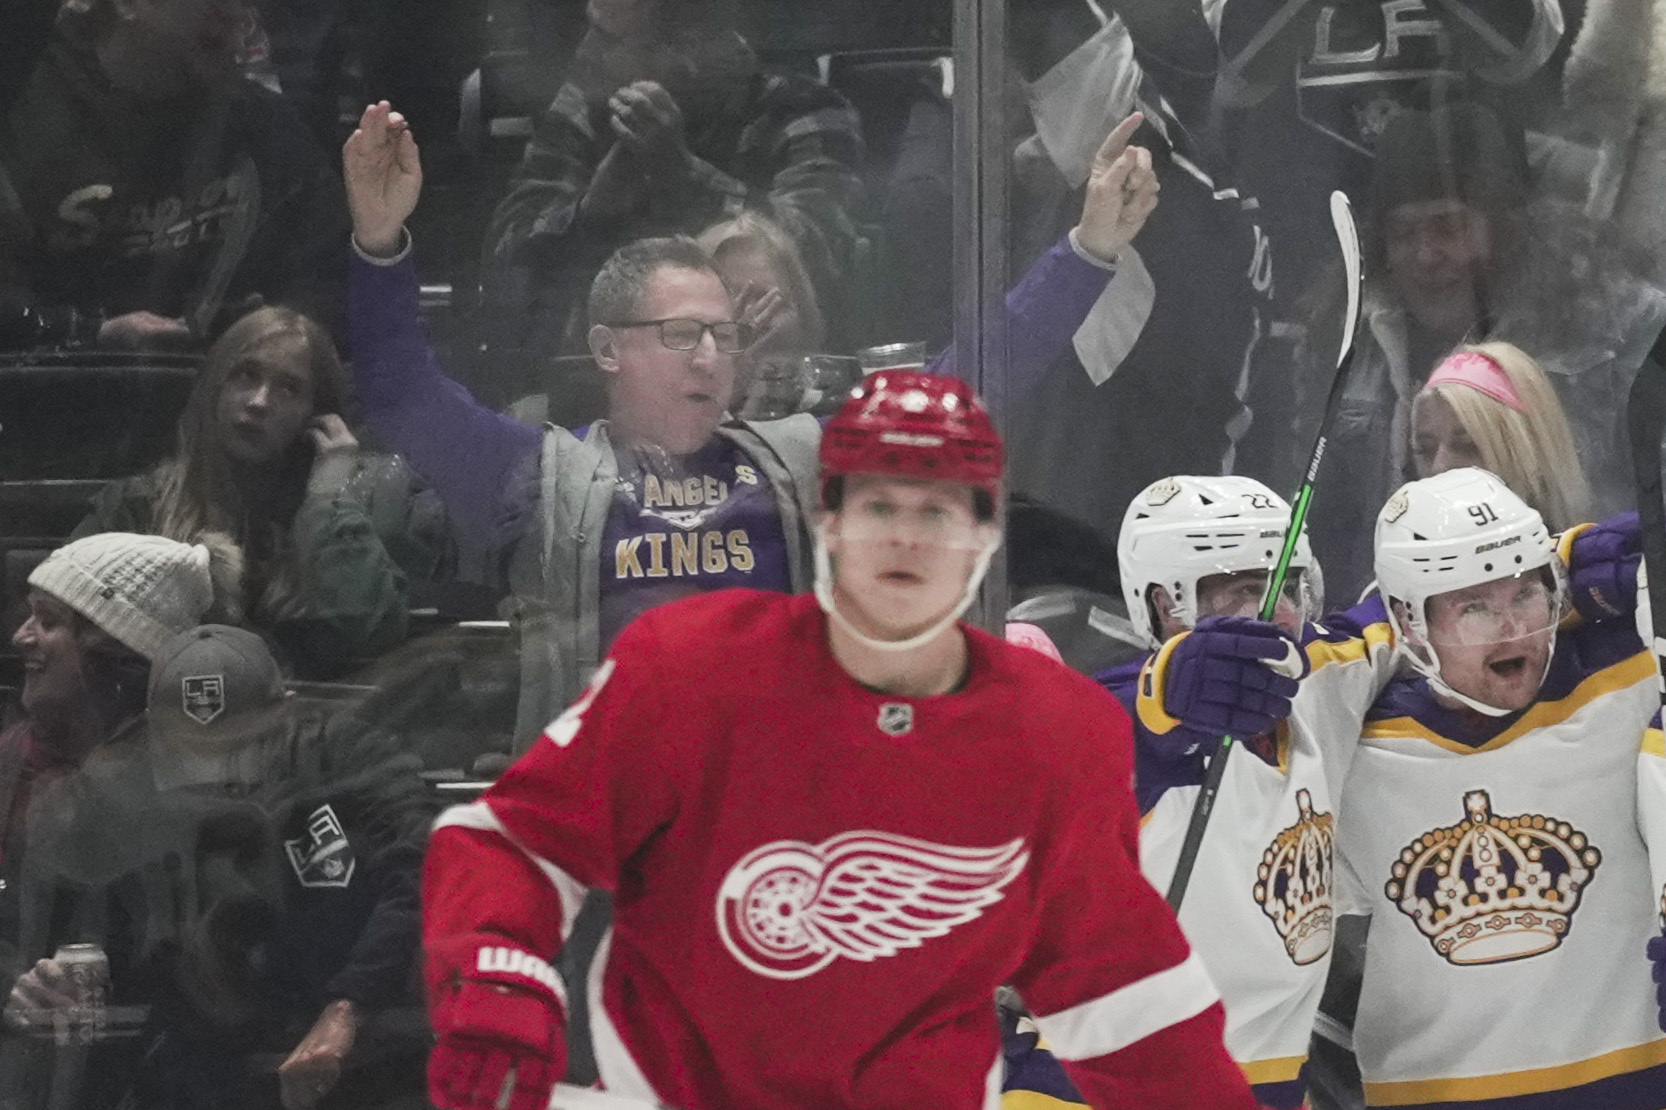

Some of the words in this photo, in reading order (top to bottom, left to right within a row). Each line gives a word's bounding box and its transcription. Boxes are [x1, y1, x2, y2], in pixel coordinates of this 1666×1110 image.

[1241, 494, 1279, 510] 22
[1467, 501, 1500, 527] 91
[614, 529, 756, 579] KINGS
[1474, 534, 1522, 555] BAUER
[186, 680, 220, 697] LA
